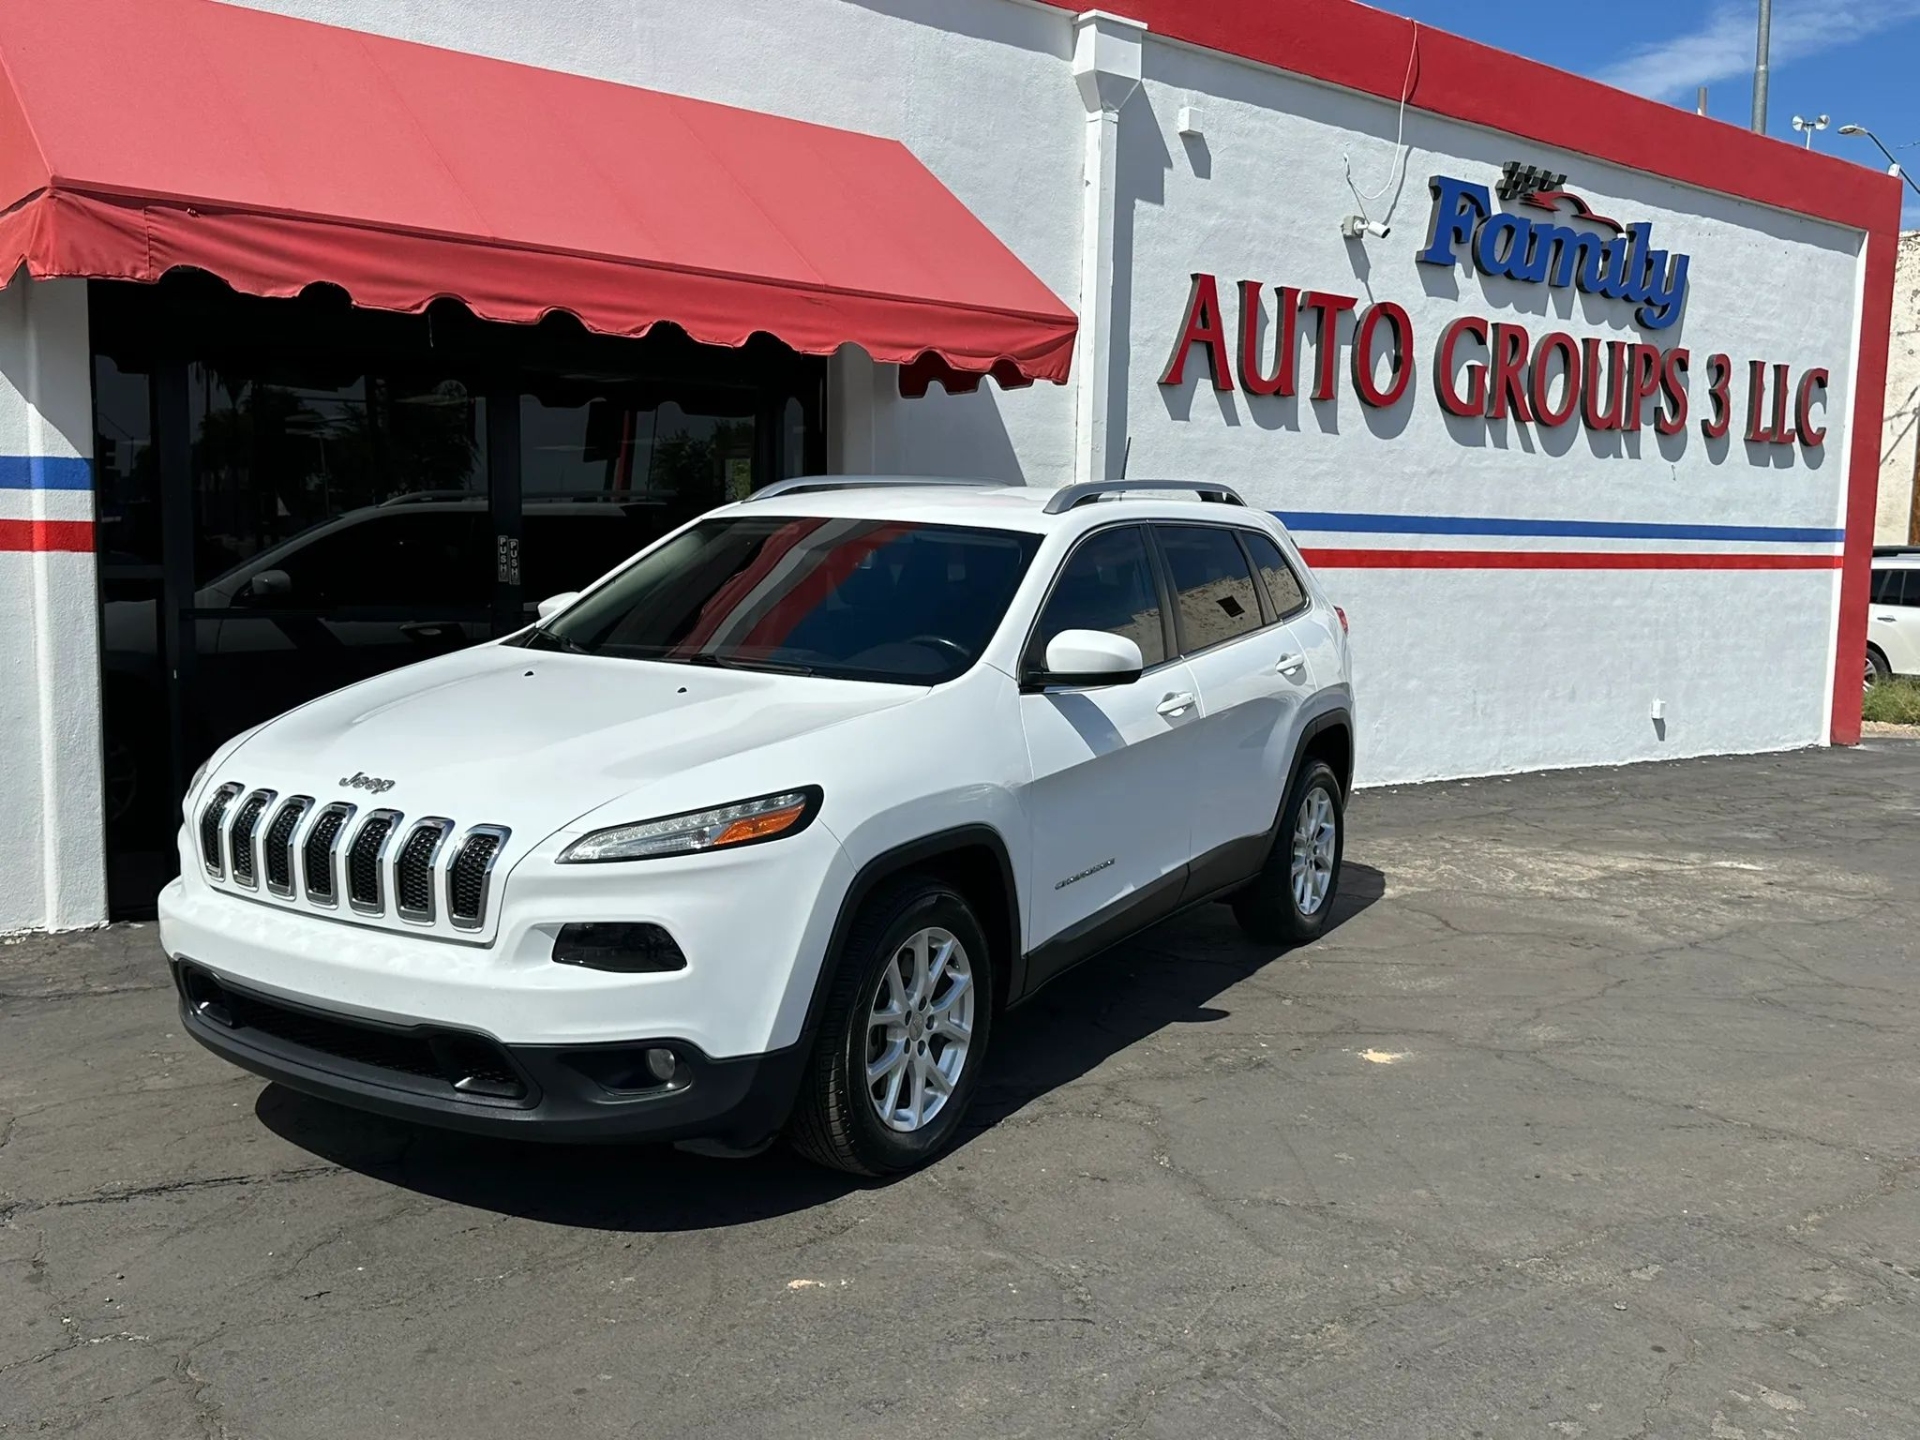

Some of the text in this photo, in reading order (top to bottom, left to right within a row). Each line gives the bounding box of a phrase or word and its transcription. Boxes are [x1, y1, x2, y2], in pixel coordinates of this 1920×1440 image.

[1416, 174, 1690, 330] Family
[1158, 272, 1830, 447] AUTO GROUPS 3 LLC
[499, 537, 507, 572] PUSH
[510, 541, 518, 576] PUSH
[338, 771, 396, 795] Jeep
